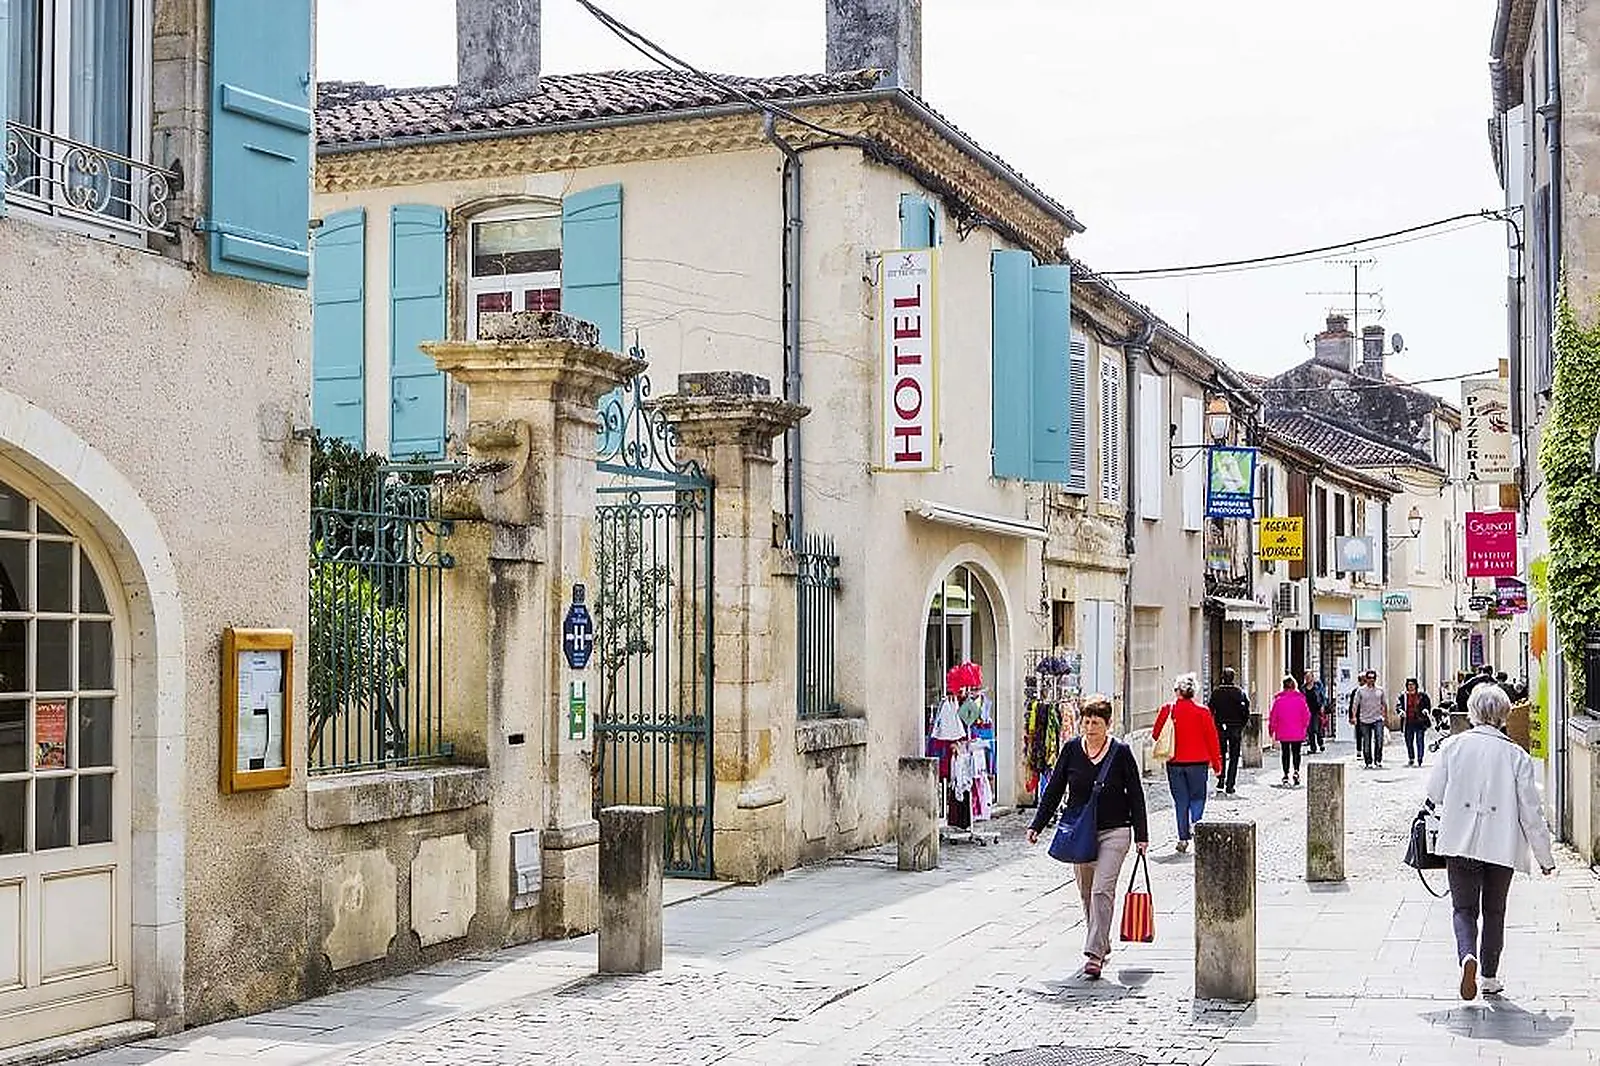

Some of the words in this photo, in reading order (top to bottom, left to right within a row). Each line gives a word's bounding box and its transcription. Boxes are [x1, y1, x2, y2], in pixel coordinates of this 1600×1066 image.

[893, 283, 923, 462] HOTEL
[1466, 396, 1479, 481] PIZZERIA
[1263, 521, 1299, 532] AGENCE
[1261, 546, 1301, 557] VOYAGES
